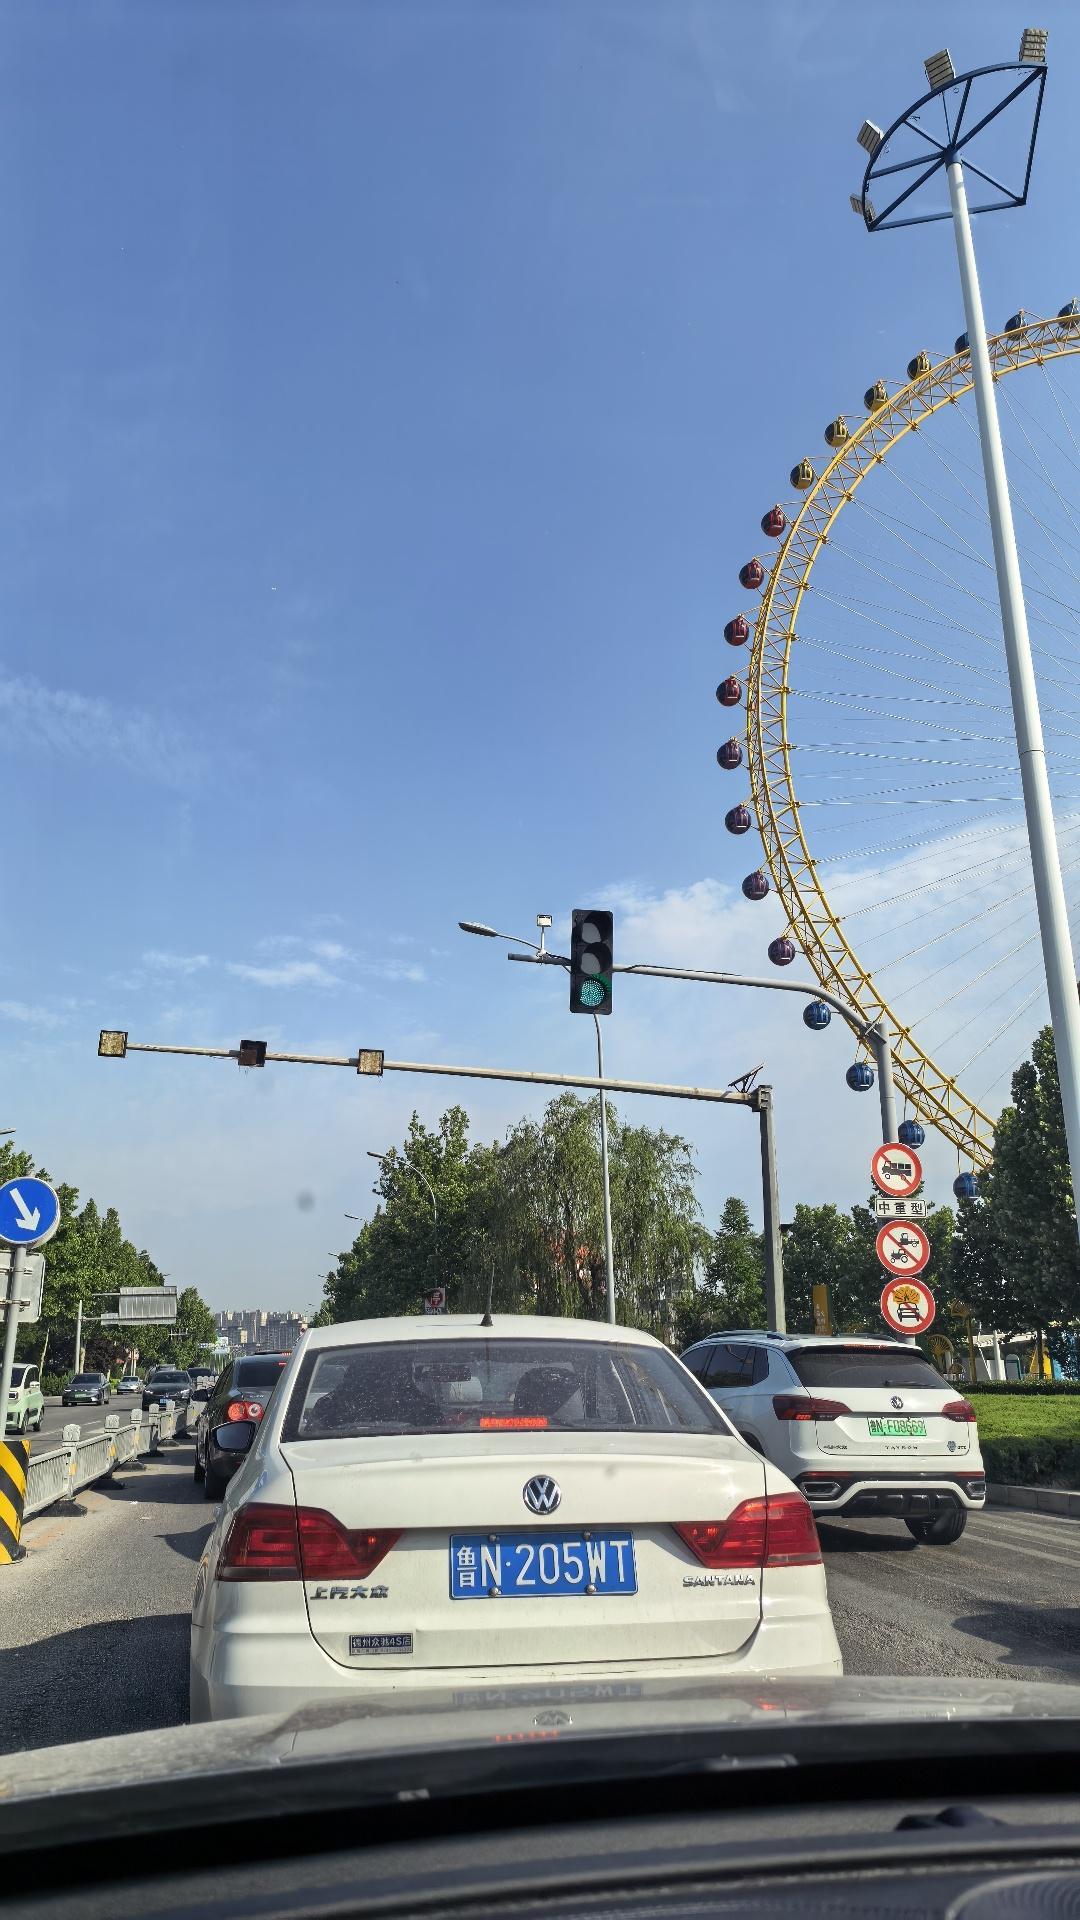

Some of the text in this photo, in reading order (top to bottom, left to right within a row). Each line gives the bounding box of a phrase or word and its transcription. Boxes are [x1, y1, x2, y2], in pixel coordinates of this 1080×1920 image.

[879, 1201, 923, 1215] 中重型
[456, 1540, 629, 1588] 鲁N·205WT
[682, 1574, 755, 1587] SANTANA
[310, 1584, 389, 1600] 上汽大众
